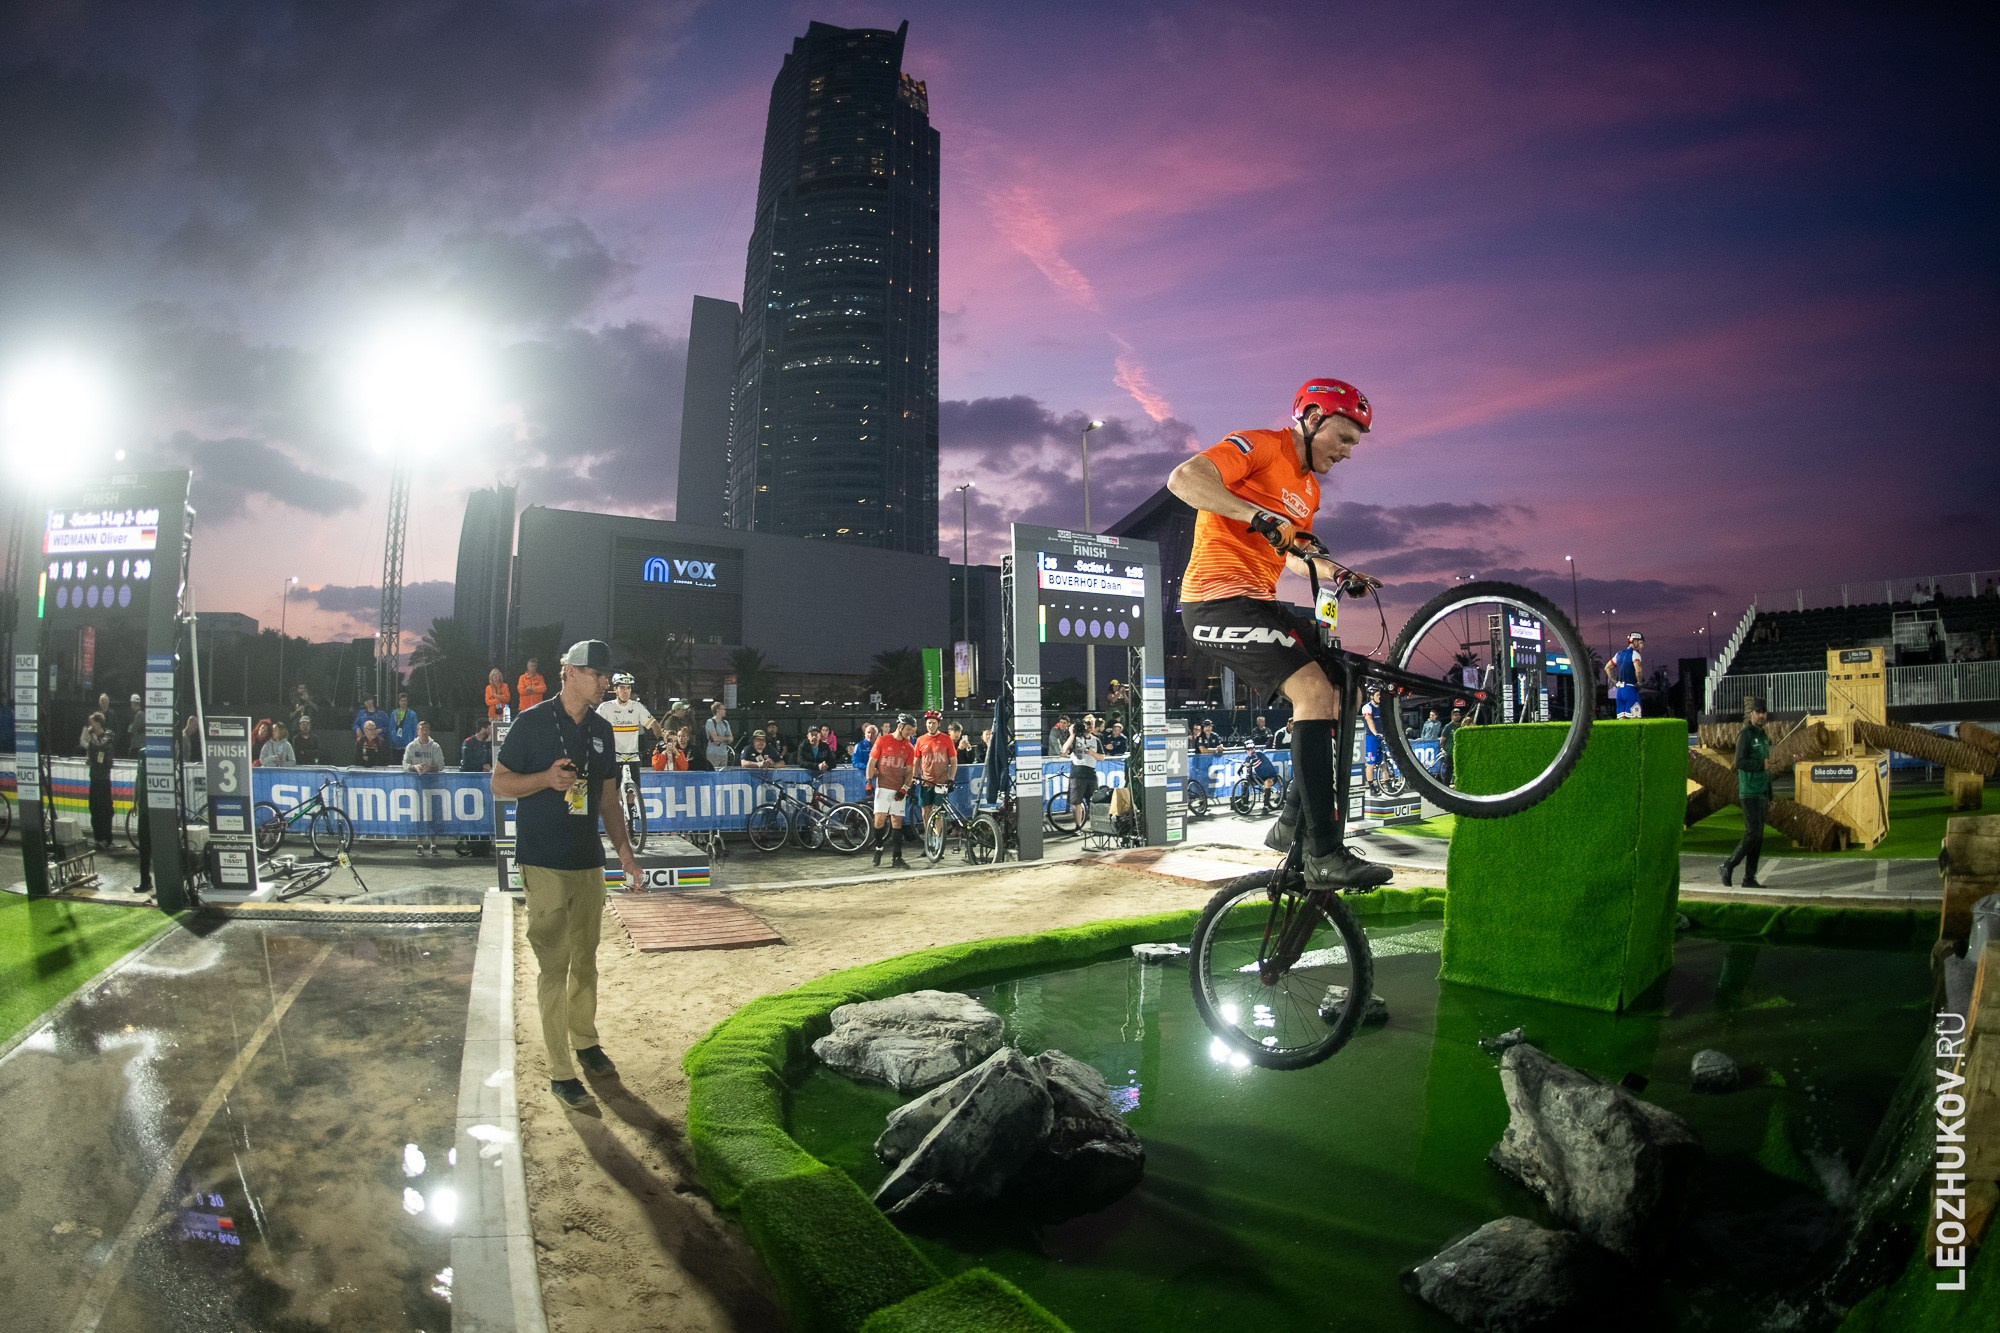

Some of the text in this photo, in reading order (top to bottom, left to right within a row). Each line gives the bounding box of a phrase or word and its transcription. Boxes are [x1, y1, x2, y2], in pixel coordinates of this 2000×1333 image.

[82, 492, 120, 504] FINISH
[53, 531, 128, 546] WIDMANN Oliver
[1073, 544, 1107, 558] FINISH
[133, 559, 151, 580] 30
[673, 559, 716, 580] VOX
[1048, 574, 1122, 590] BOVERHOF Daan
[1326, 602, 1336, 618] 35
[1193, 625, 1296, 648] CLEAN
[19, 657, 34, 667] UCI
[208, 745, 247, 757] FINISH
[1167, 739, 1187, 749] NISH
[1353, 743, 1361, 762] 5
[1167, 751, 1181, 774] 4
[20, 771, 35, 781] UCI
[218, 760, 237, 792] 3
[1023, 772, 1040, 780] UCI
[1837, 767, 1853, 775] dhabi
[152, 778, 170, 788] UCI
[271, 784, 484, 822] SHIMANO
[639, 783, 846, 819] SHIMANO
[1395, 806, 1410, 816] UCI
